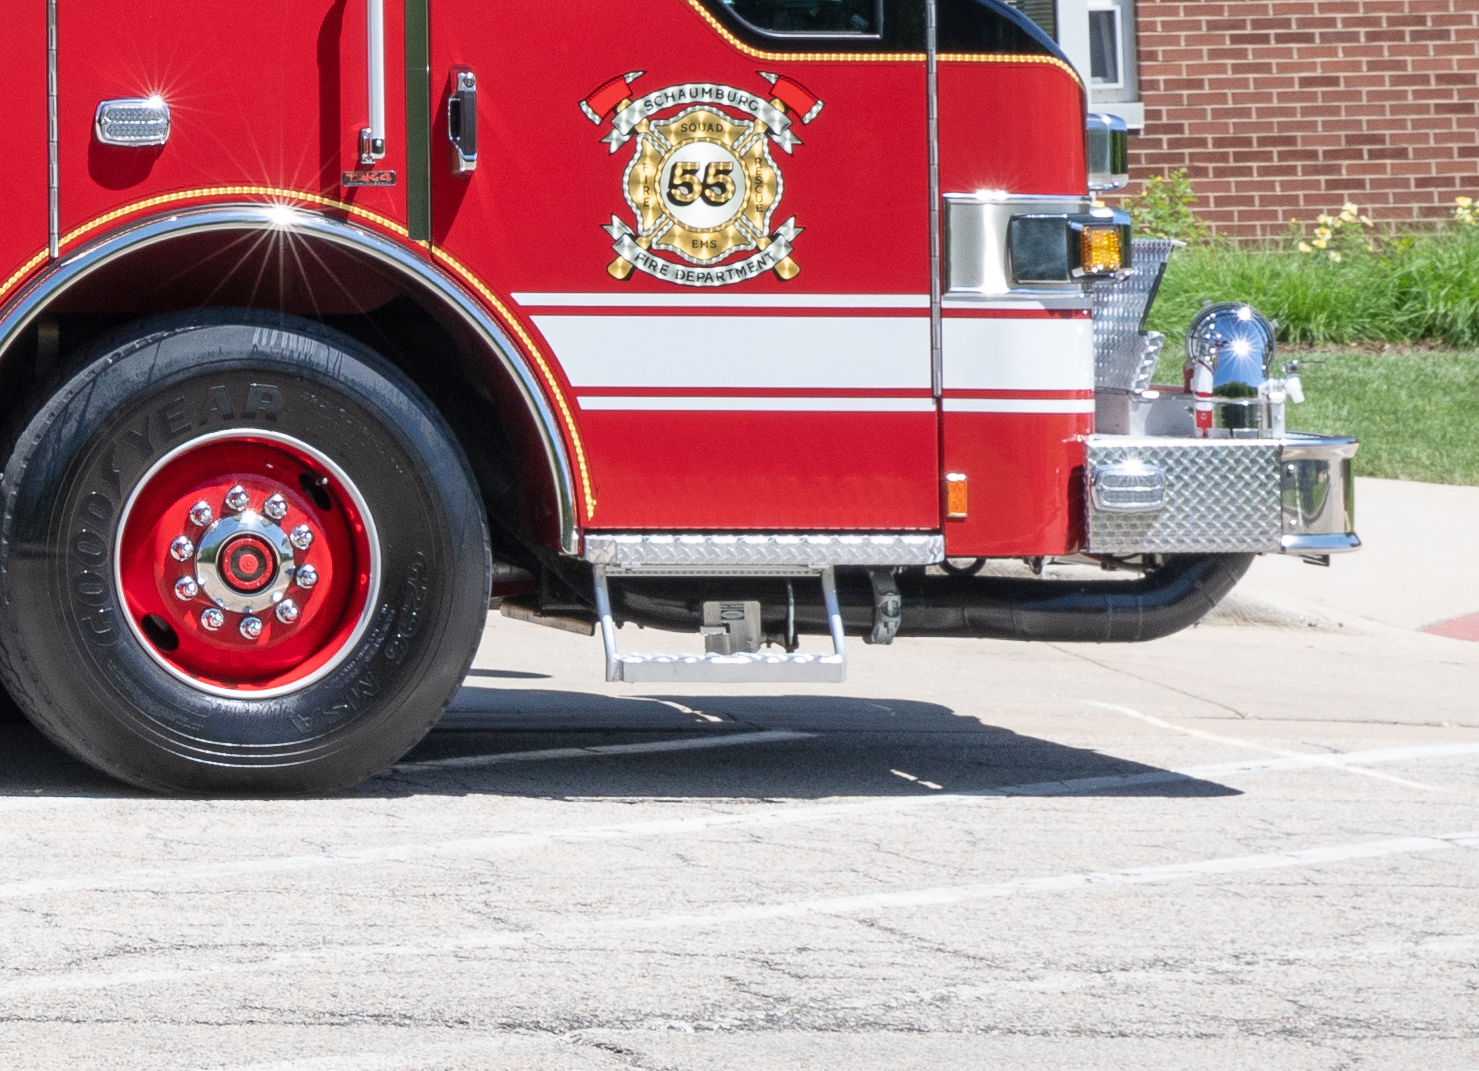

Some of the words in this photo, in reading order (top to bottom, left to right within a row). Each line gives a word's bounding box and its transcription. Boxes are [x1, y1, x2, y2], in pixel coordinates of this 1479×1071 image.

[643, 87, 759, 113] SCHAUMBURG
[680, 122, 724, 134] SQUAD
[642, 162, 651, 208] FIRE
[666, 161, 737, 207] 55
[754, 157, 764, 213] RESCUE
[691, 239, 717, 249] EMS
[634, 252, 669, 276] FIRE
[675, 251, 776, 283] DEPARTMENT
[70, 382, 283, 647] GOODYEAR
